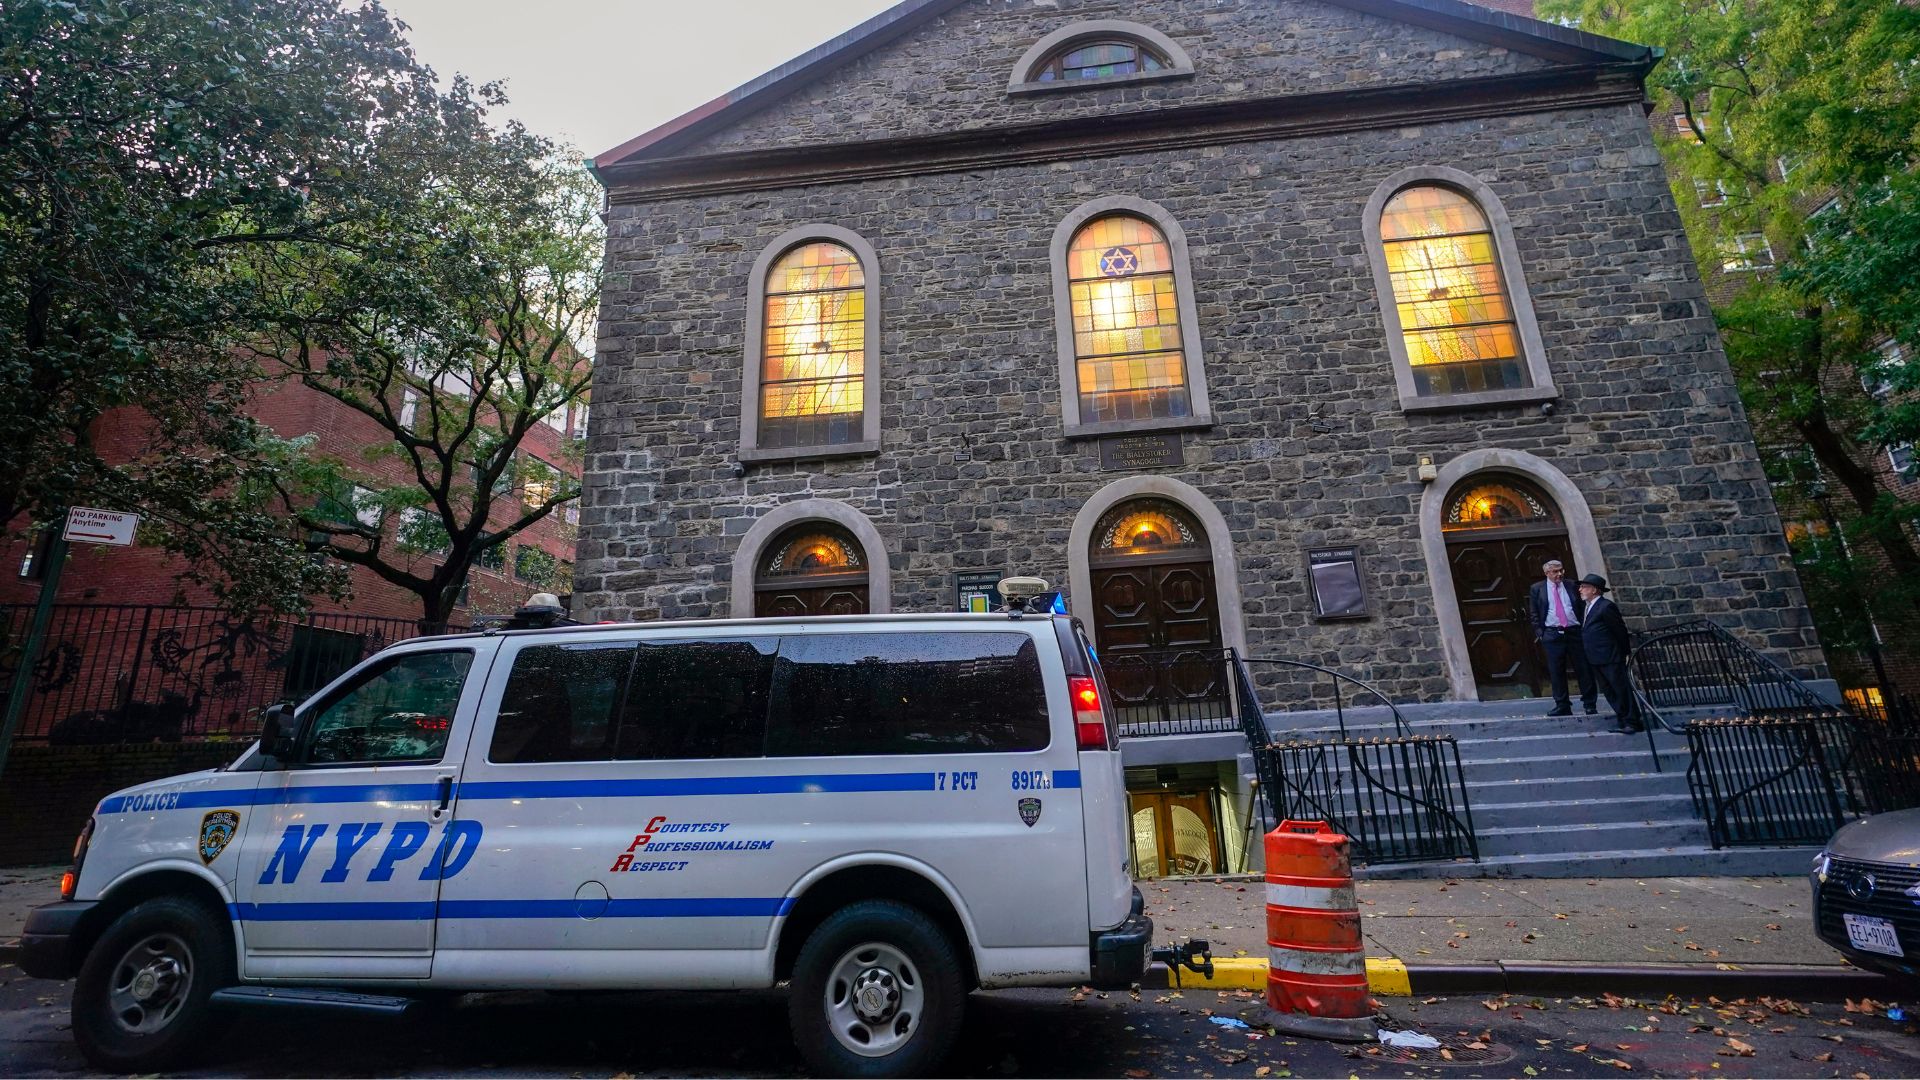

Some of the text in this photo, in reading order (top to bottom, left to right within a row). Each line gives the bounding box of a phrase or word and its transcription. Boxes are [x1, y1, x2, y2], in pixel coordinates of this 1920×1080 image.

[1112, 449, 1172, 460] THE BIALYSTOKER
[1122, 458, 1163, 467] SYNAGOGUE
[72, 518, 106, 528] Anytime
[73, 510, 122, 522] NO PARKING
[938, 771, 978, 791] 7 PCT
[1011, 770, 1043, 790] 8917
[121, 793, 179, 813] POLICE
[212, 812, 233, 820] POLICE
[644, 816, 730, 833] COURTESY
[258, 819, 483, 885] NYPD
[626, 835, 774, 852] PROFESSIONALISM
[610, 854, 688, 872] RESPECT
